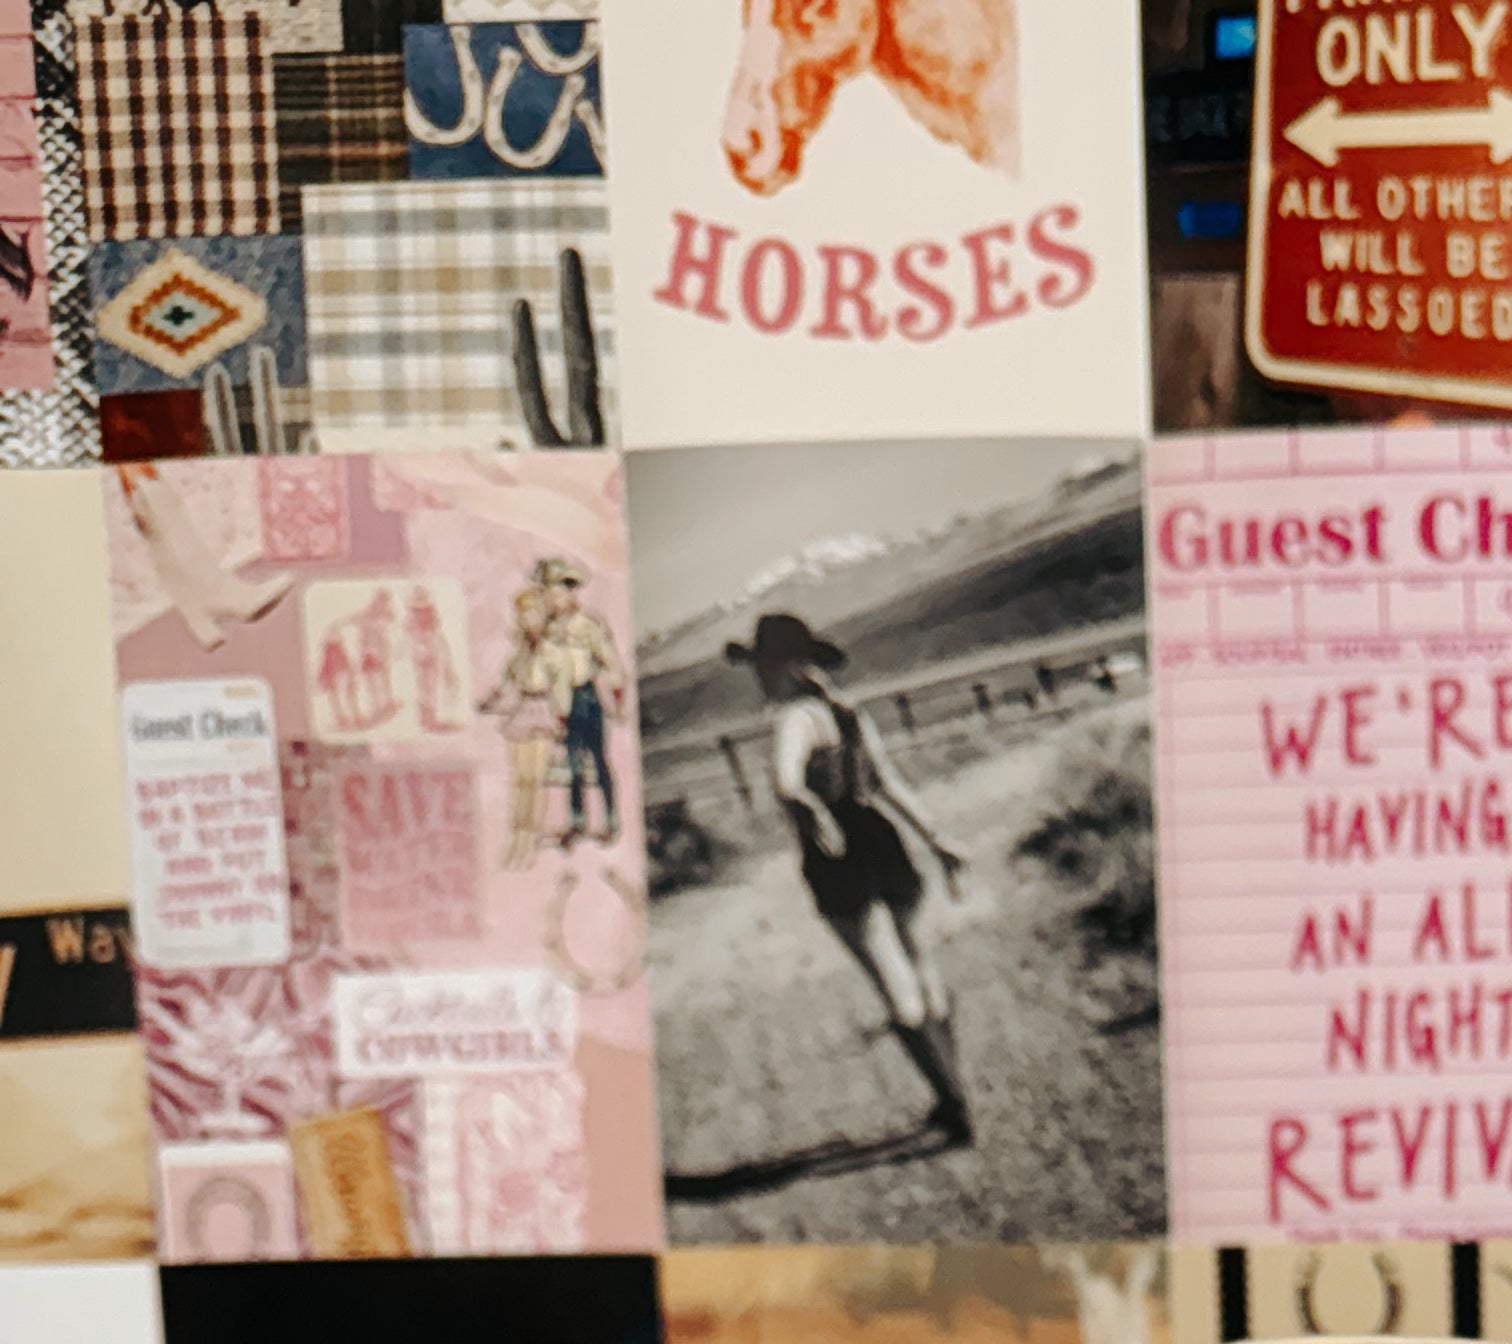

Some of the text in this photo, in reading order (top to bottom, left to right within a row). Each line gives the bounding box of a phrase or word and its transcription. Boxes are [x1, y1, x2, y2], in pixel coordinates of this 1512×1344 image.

[1316, 3, 1509, 87] ONLY
[1278, 176, 1361, 221] ALL
[652, 203, 1095, 342] HORSES
[1319, 230, 1511, 281] WILL BE
[1158, 500, 1388, 574] Guest
[1305, 779, 1512, 865] HAVING
[1290, 893, 1376, 973] AN
